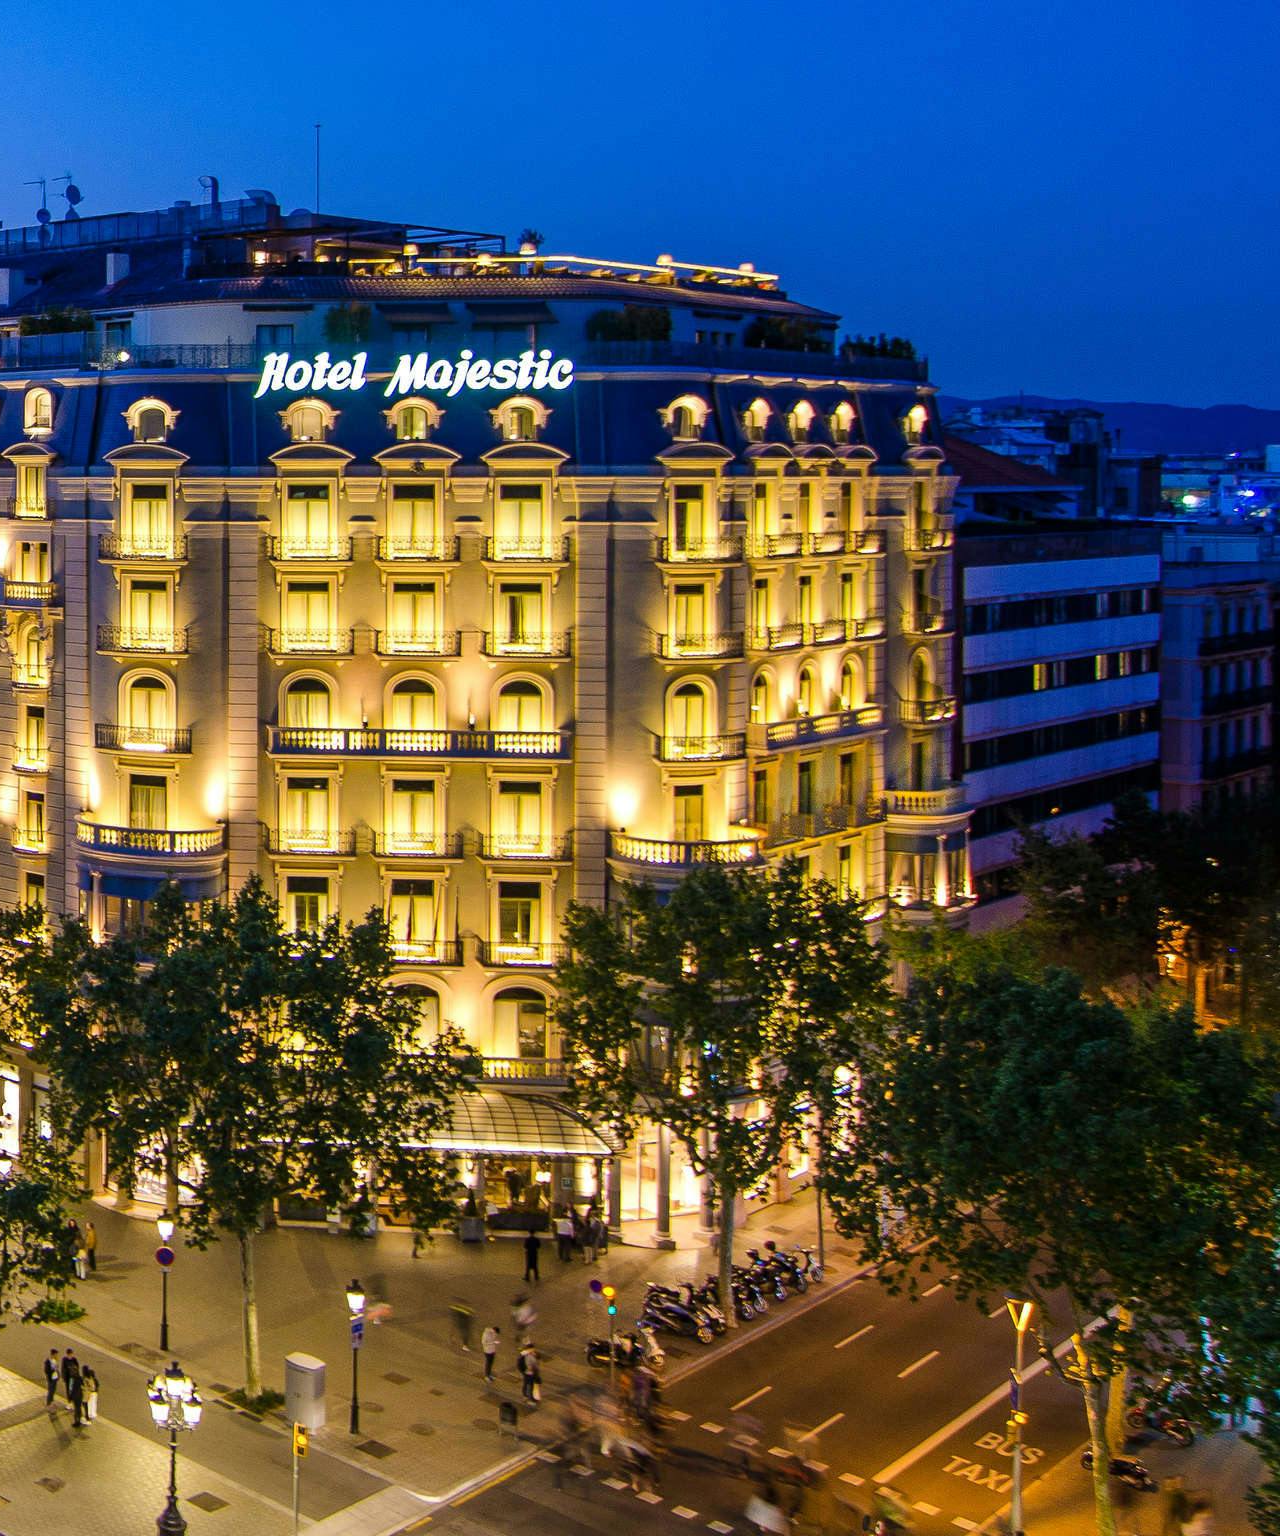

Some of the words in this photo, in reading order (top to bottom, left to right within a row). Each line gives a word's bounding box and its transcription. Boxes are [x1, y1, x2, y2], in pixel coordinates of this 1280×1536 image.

[253, 351, 368, 399] Hotel
[384, 349, 575, 397] Majestic
[973, 1432, 1046, 1465] BUS
[941, 1455, 1015, 1494] TAXI
